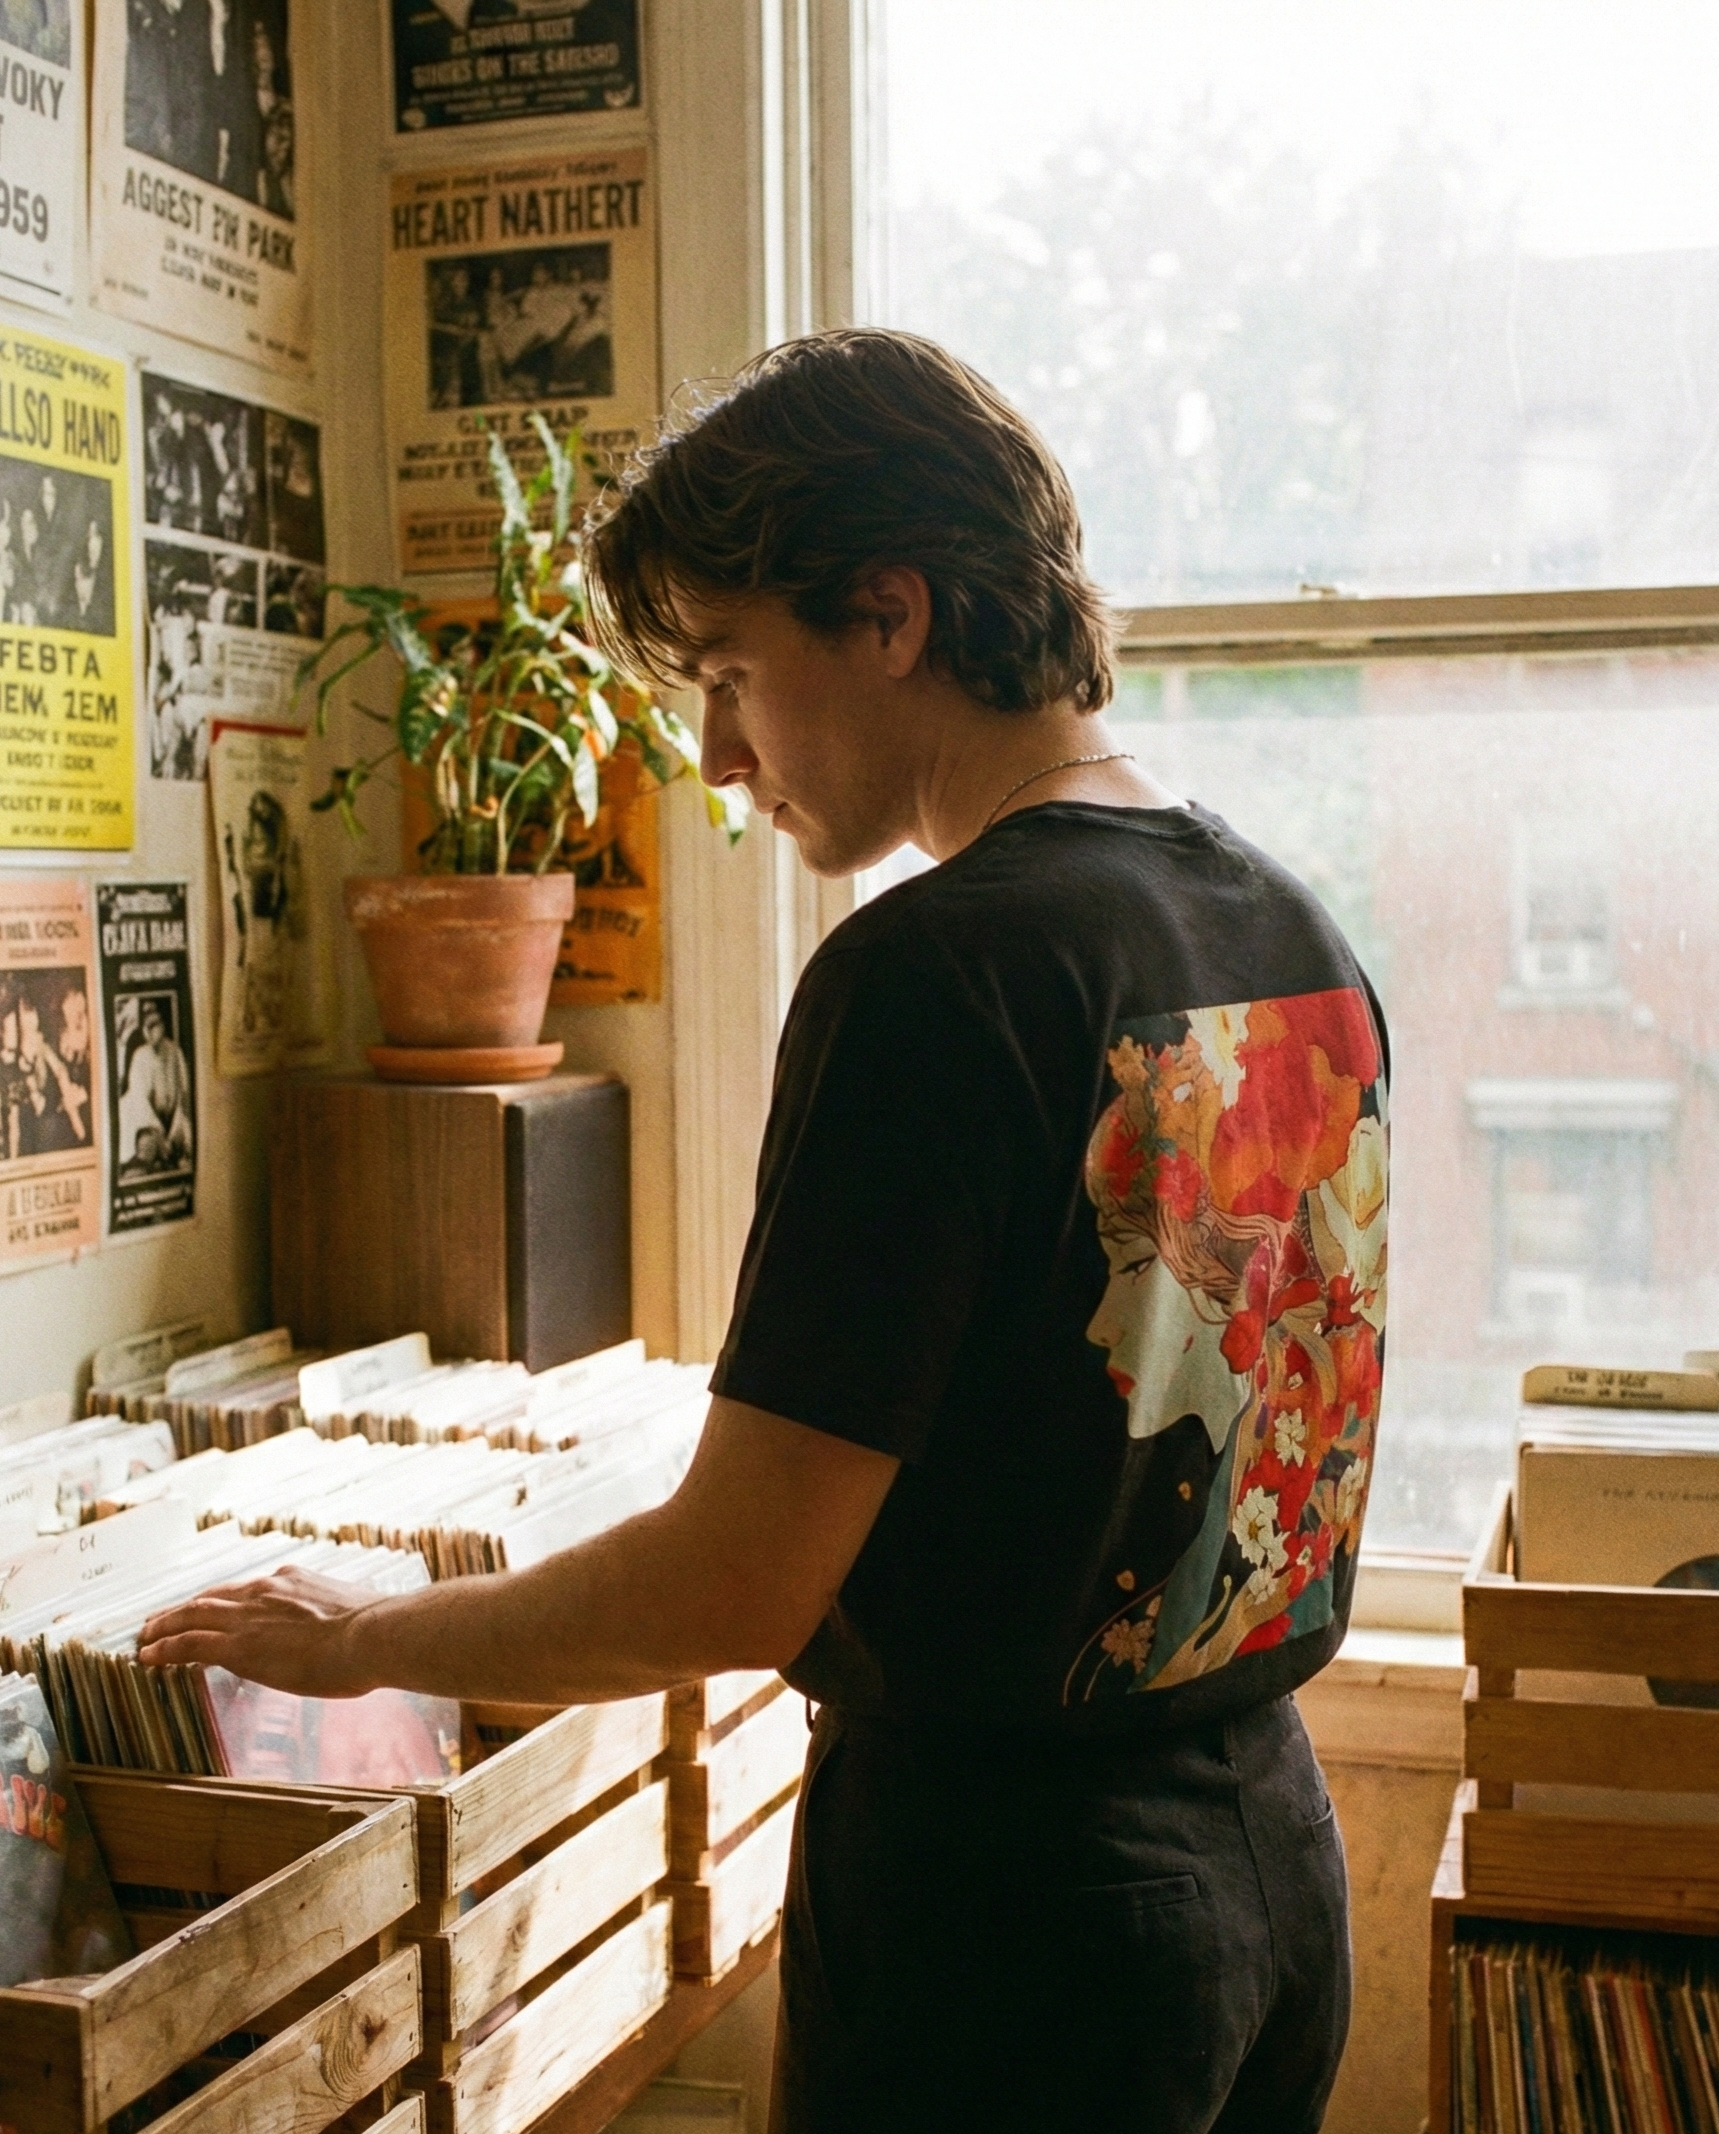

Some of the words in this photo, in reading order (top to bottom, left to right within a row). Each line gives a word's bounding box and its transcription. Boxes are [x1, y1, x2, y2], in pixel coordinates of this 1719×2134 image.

[393, 196, 489, 249] HEART
[500, 179, 644, 239] NATHERT
[62, 398, 121, 466] HAND
